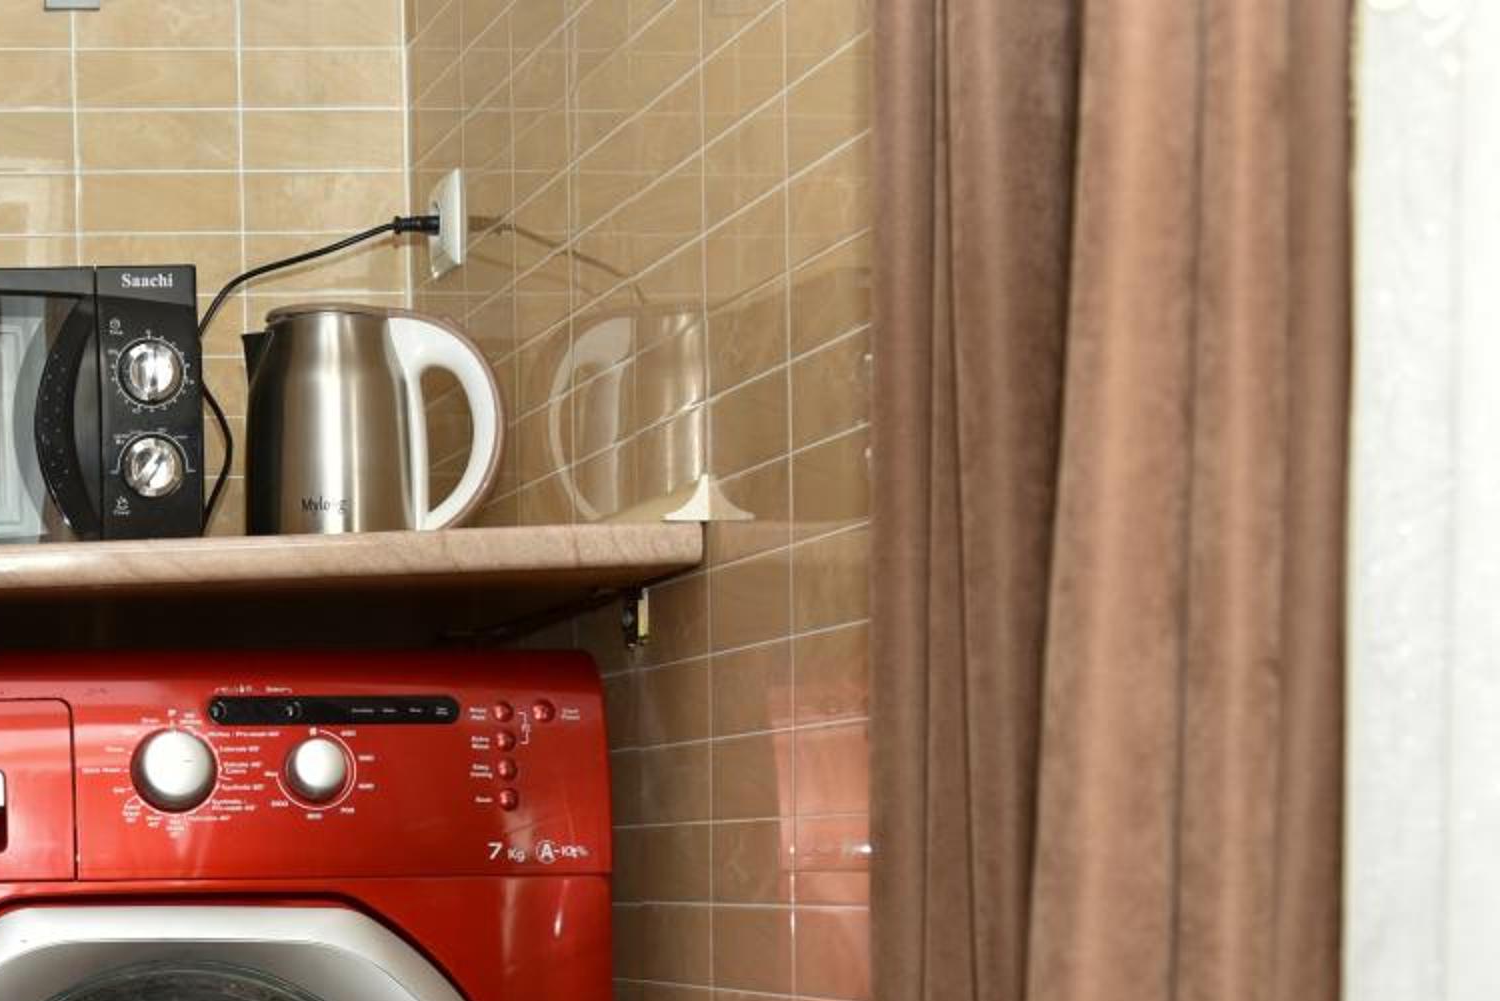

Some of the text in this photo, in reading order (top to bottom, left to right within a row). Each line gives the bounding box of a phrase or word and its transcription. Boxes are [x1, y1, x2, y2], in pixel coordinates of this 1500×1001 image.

[121, 272, 173, 288] Saachi
[301, 495, 349, 515] Mylog
[487, 841, 504, 861] 7
[507, 847, 526, 863] Kg
